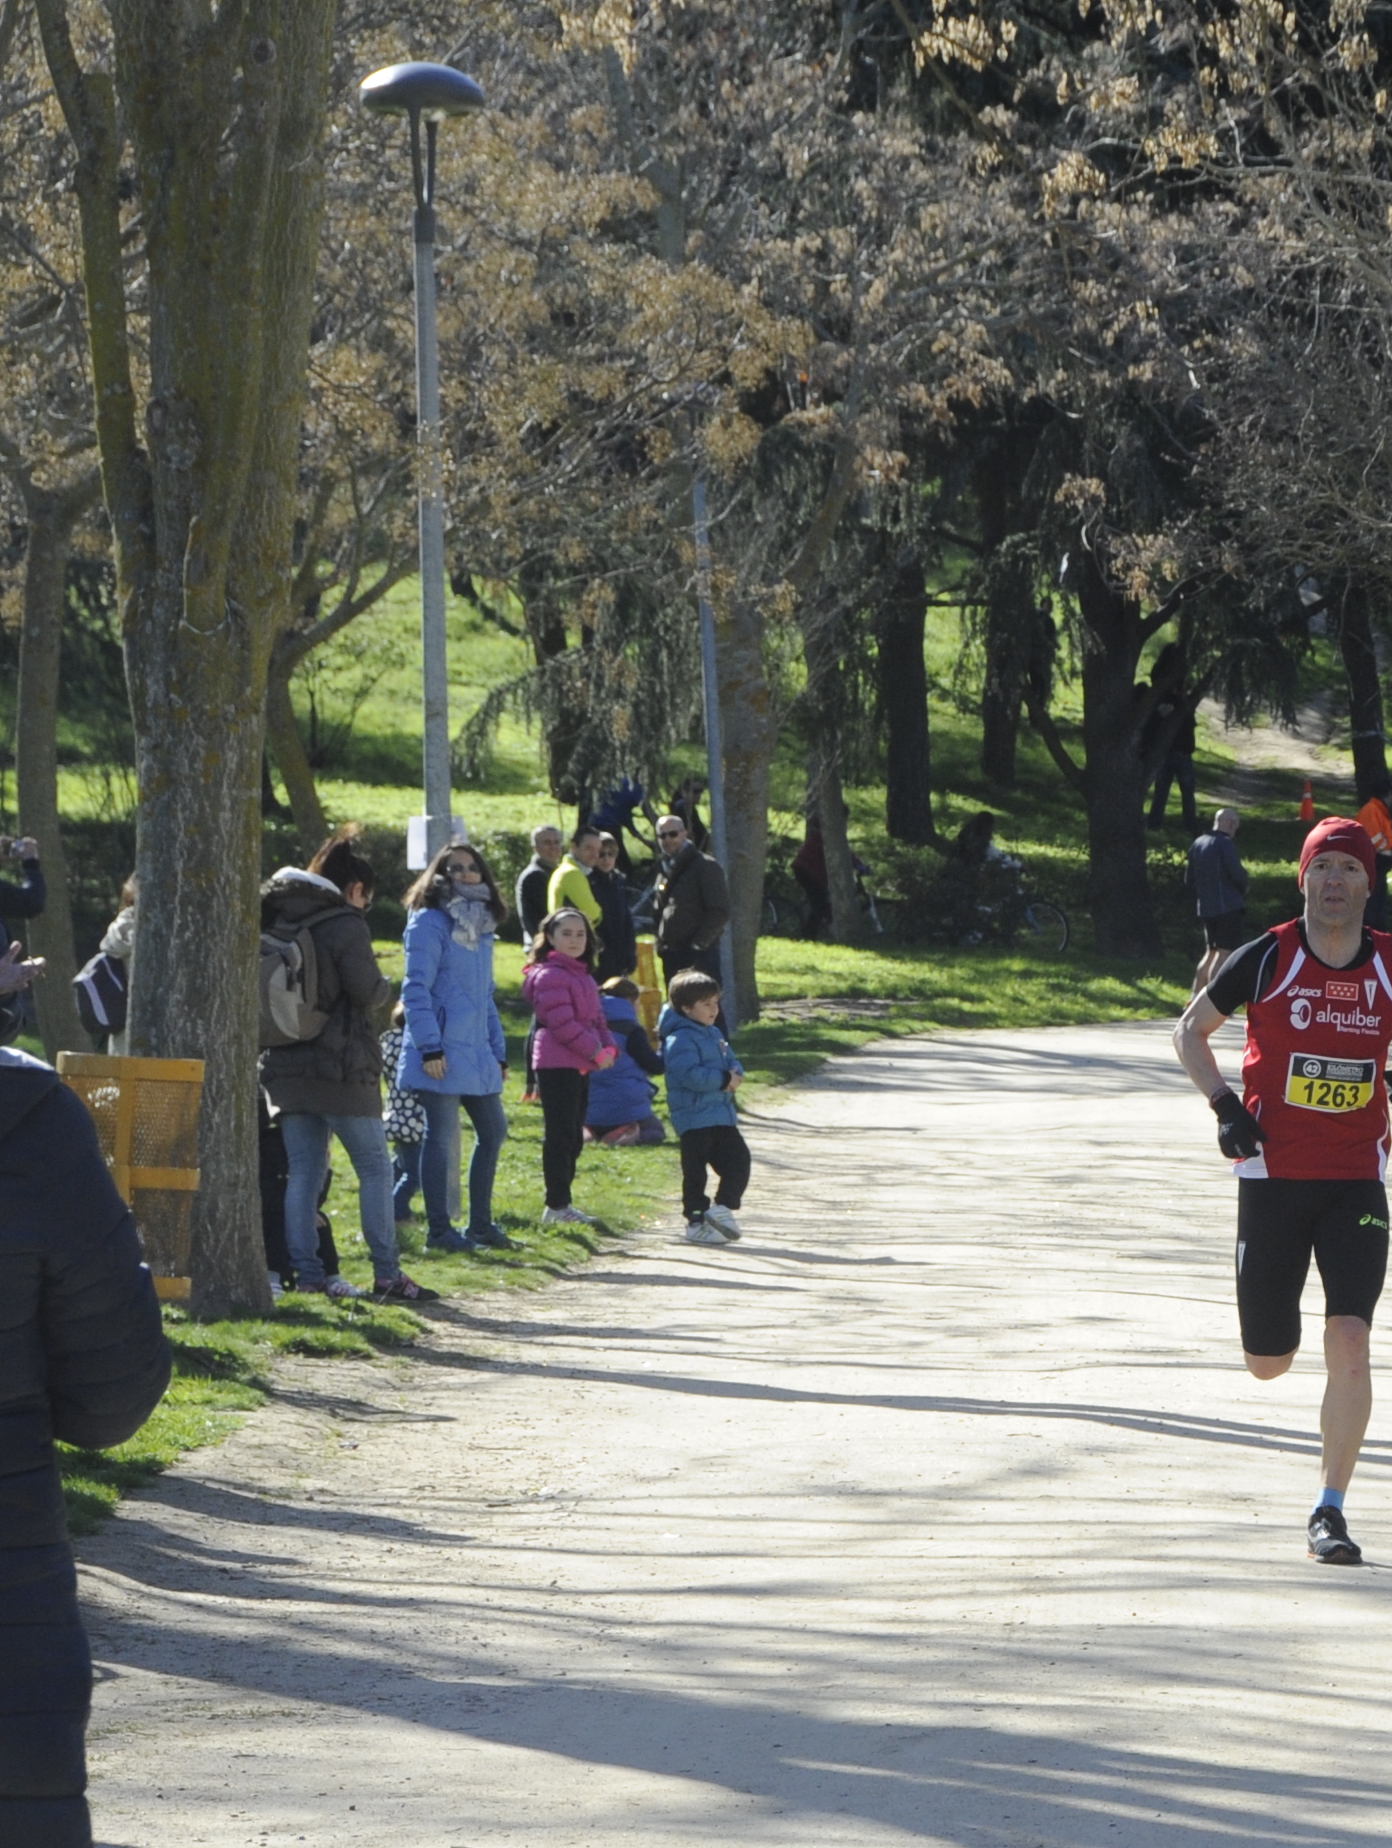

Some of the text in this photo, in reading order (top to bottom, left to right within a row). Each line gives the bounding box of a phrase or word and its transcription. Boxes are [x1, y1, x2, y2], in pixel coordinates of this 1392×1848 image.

[1298, 987, 1322, 997] asics
[1316, 1003, 1381, 1032] alquiber
[1305, 1064, 1318, 1074] 42
[1303, 1080, 1360, 1108] 1263
